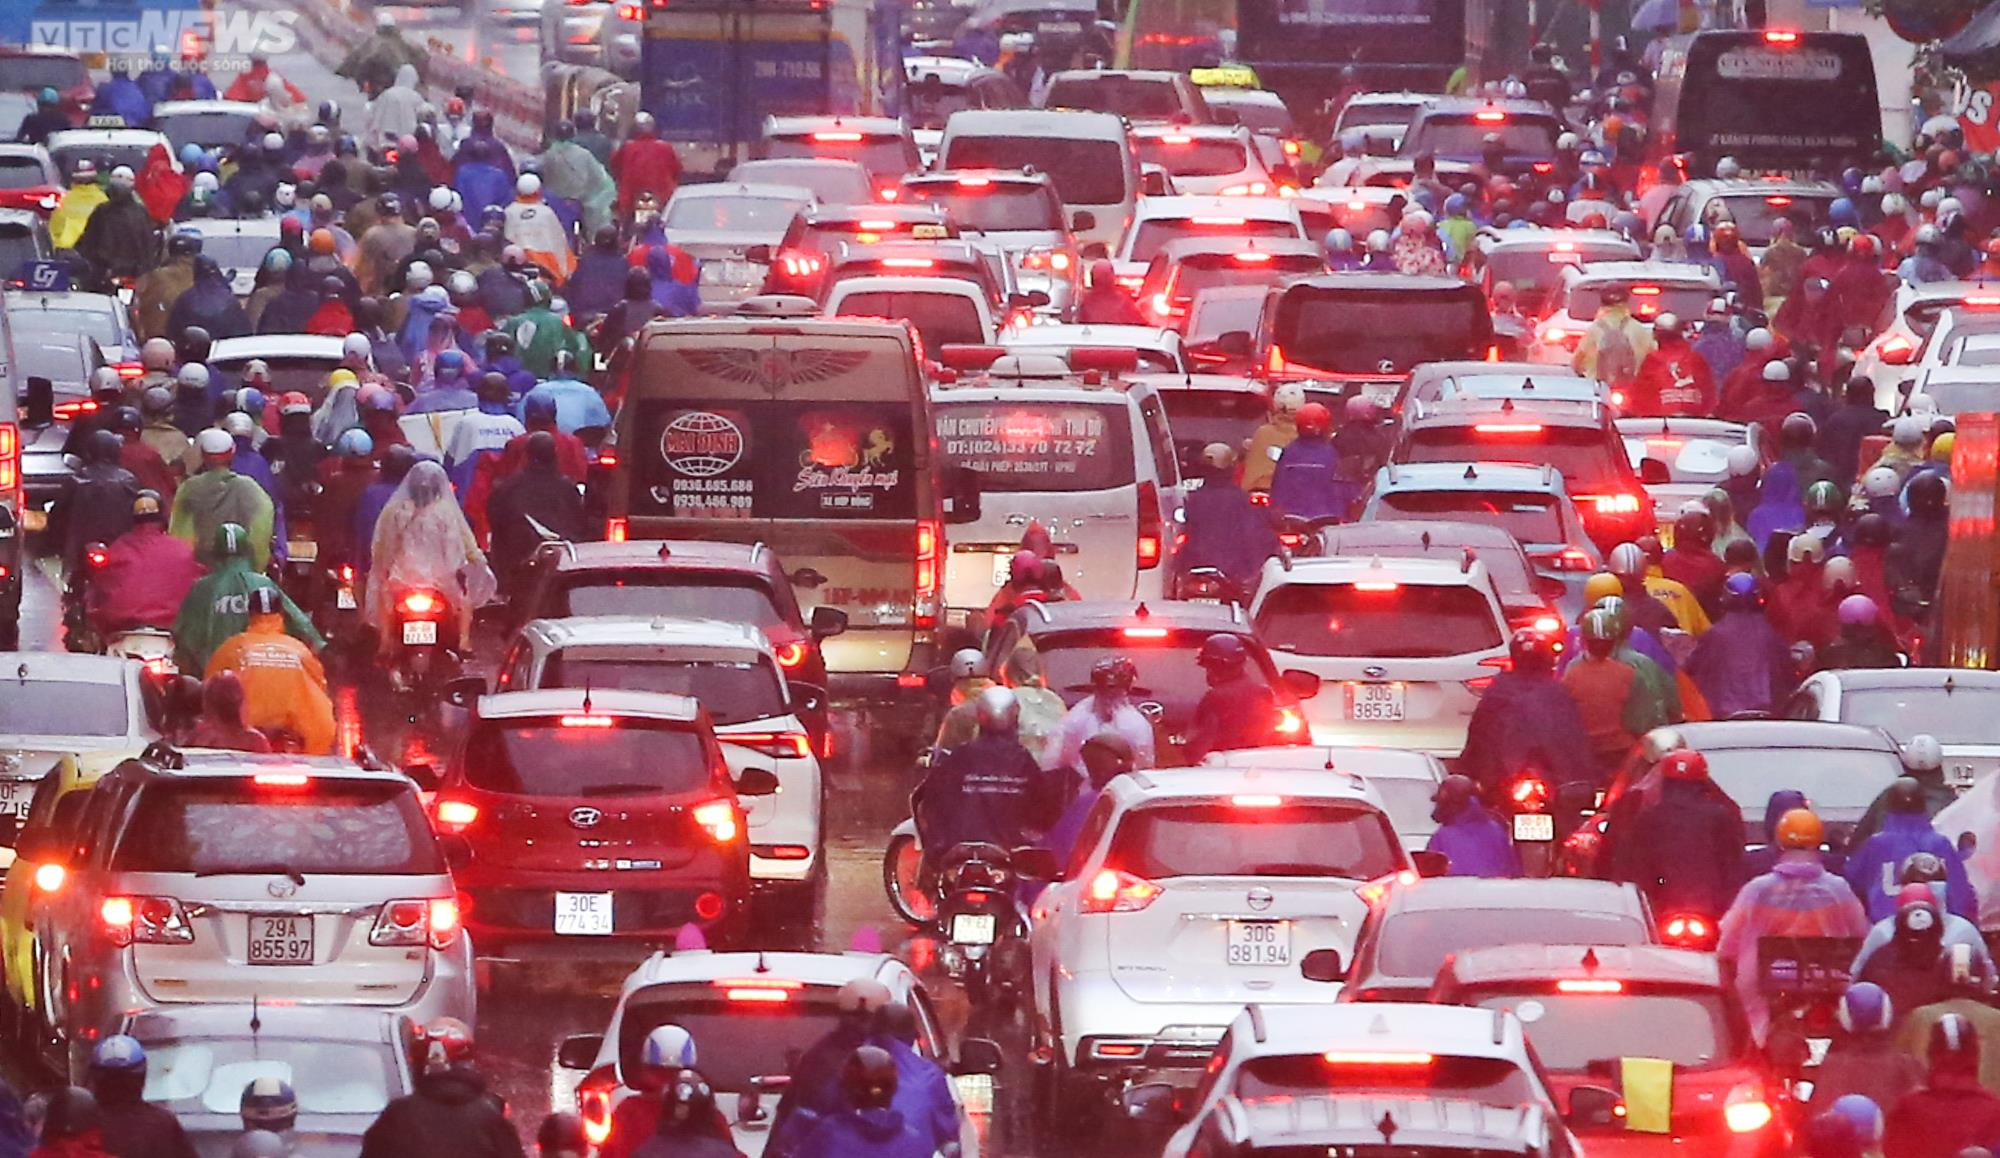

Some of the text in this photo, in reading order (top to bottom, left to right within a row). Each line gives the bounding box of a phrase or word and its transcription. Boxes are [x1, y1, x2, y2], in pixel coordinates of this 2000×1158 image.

[1053, 440, 1072, 454] 72
[570, 896, 598, 912] 30E
[264, 920, 297, 938] 29A
[1244, 925, 1275, 943] 30G
[1231, 945, 1288, 962] 381.94
